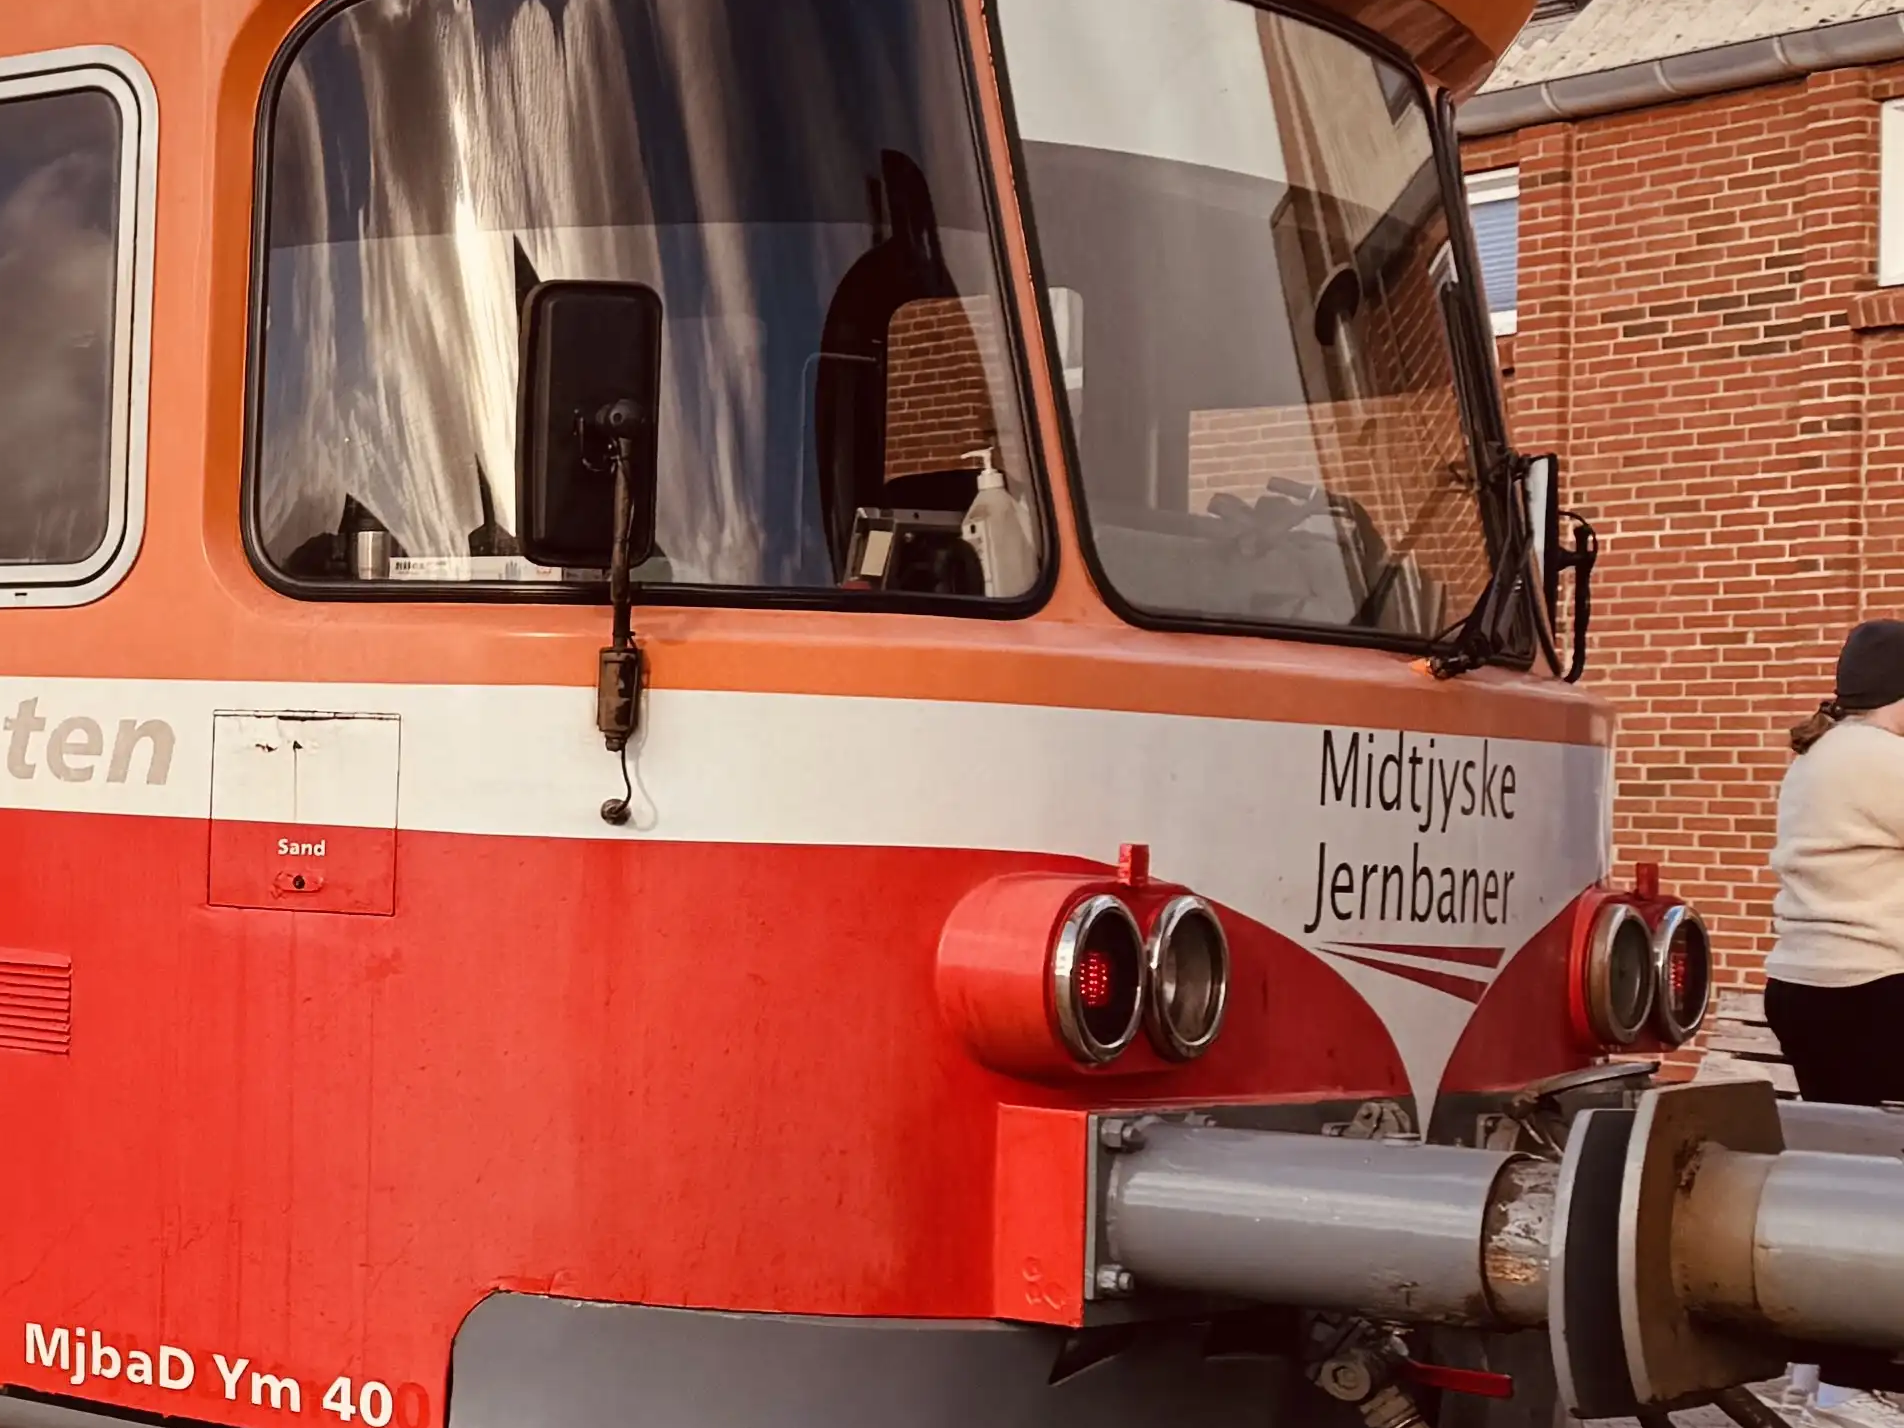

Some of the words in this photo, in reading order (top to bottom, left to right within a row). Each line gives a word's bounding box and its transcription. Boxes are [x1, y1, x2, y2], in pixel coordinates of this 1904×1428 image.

[1320, 729, 1517, 833] Midtjyske
[277, 837, 326, 857] Sand
[1304, 842, 1515, 934] Jernbaner
[23, 1321, 195, 1392] MjbaD
[213, 1354, 302, 1414] Ym
[322, 1376, 393, 1428] 40
